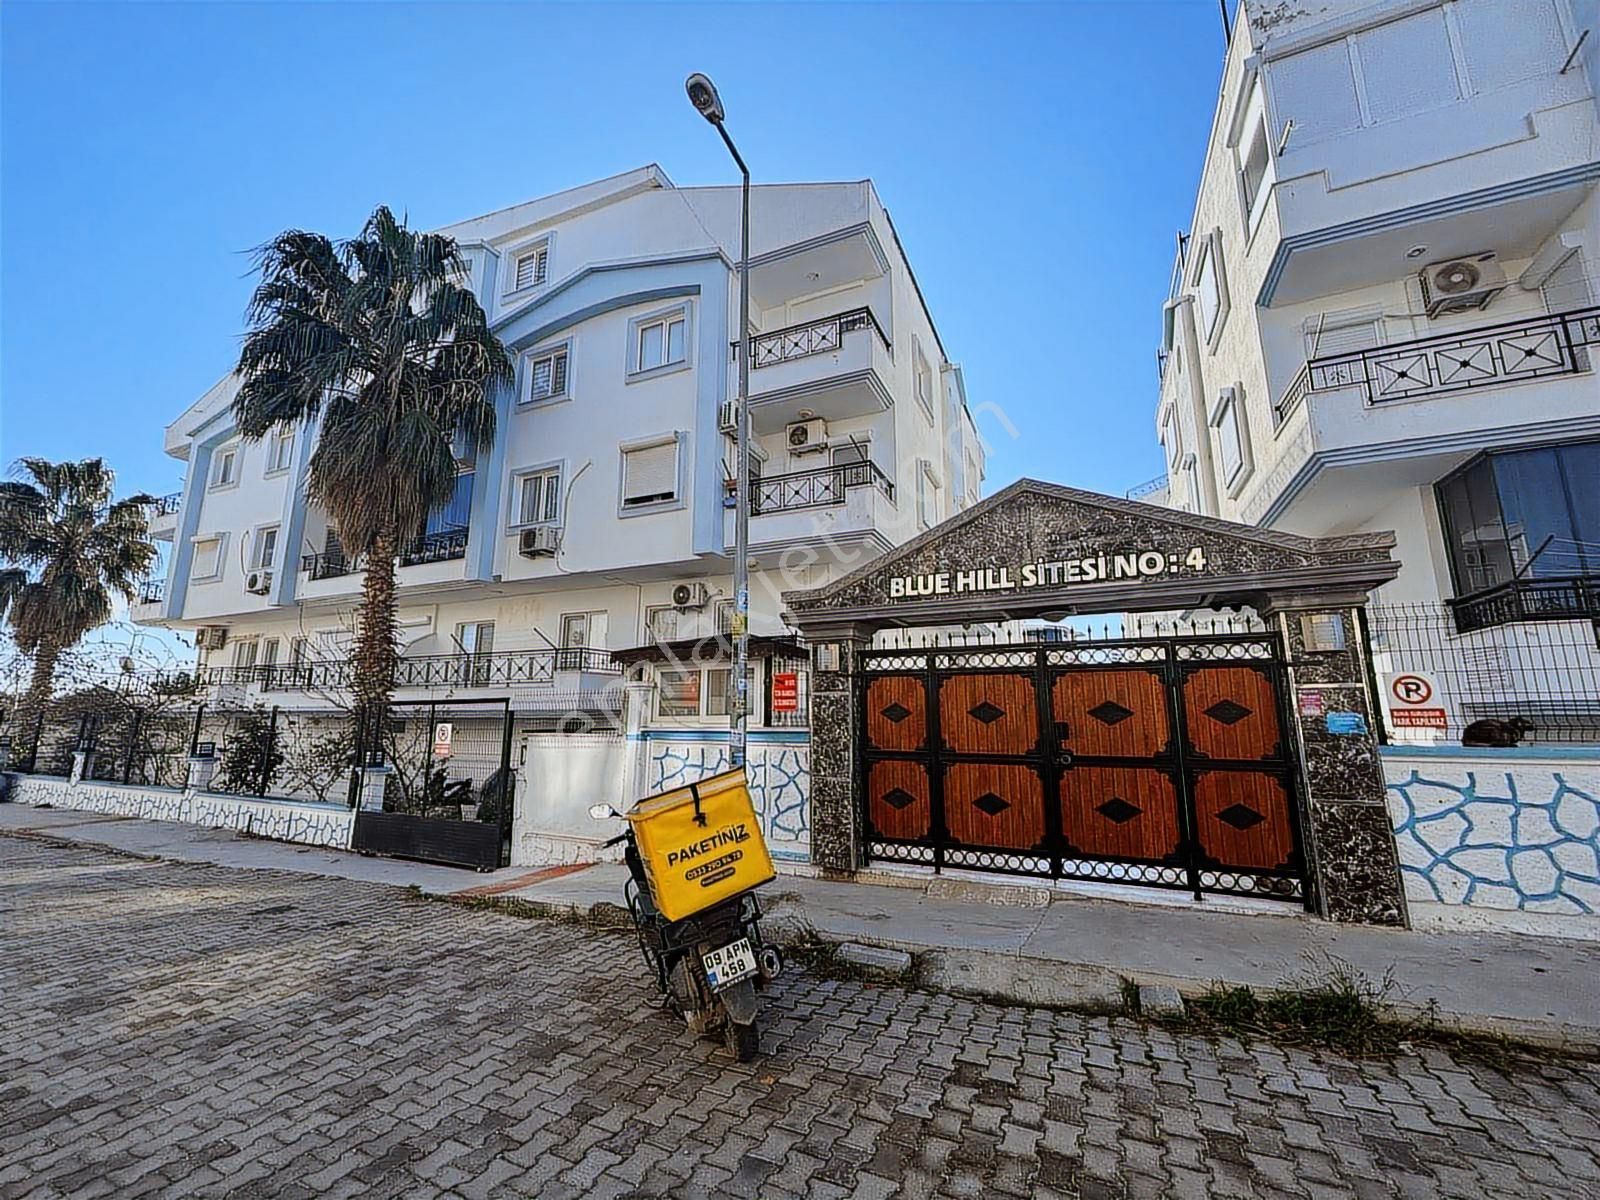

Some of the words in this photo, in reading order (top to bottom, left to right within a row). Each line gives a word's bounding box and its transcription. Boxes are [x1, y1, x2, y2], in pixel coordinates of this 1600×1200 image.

[890, 572, 950, 598] BLUE
[956, 566, 1015, 593] HILL
[1021, 551, 1106, 587] SİTESİ
[667, 823, 751, 867] PAKETİNİZ
[704, 951, 722, 969] 09
[725, 939, 750, 961] APN
[721, 958, 746, 978] 458
